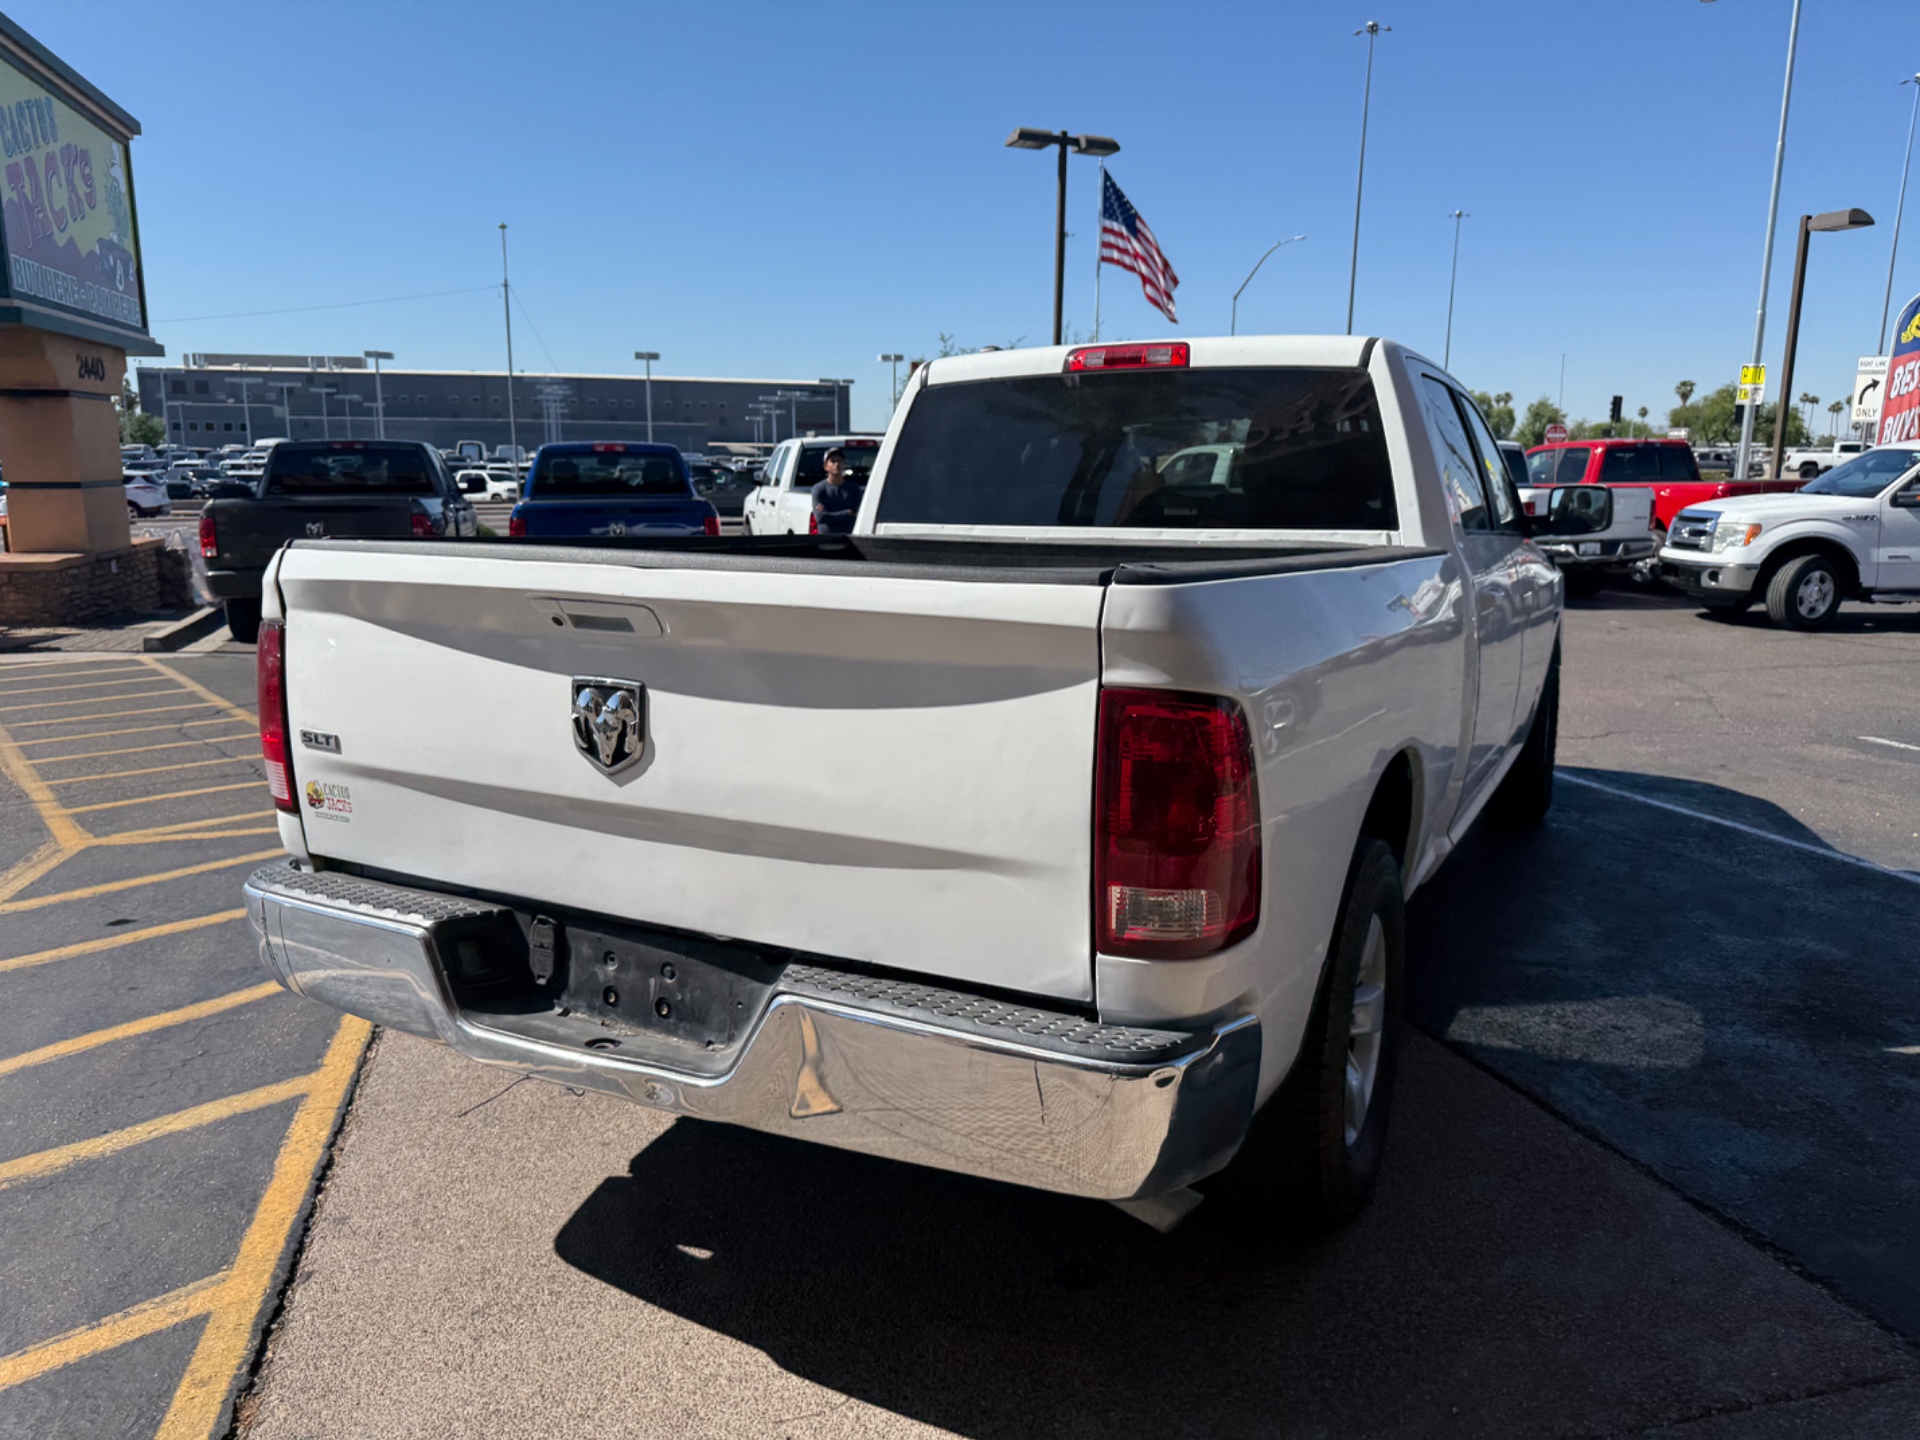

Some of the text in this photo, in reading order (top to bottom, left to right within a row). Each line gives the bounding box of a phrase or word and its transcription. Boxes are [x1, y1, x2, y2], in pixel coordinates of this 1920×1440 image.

[1890, 360, 1920, 400] BES
[1855, 407, 1878, 418] ONLY
[302, 732, 333, 746] SLT
[323, 782, 351, 800] CACTUS
